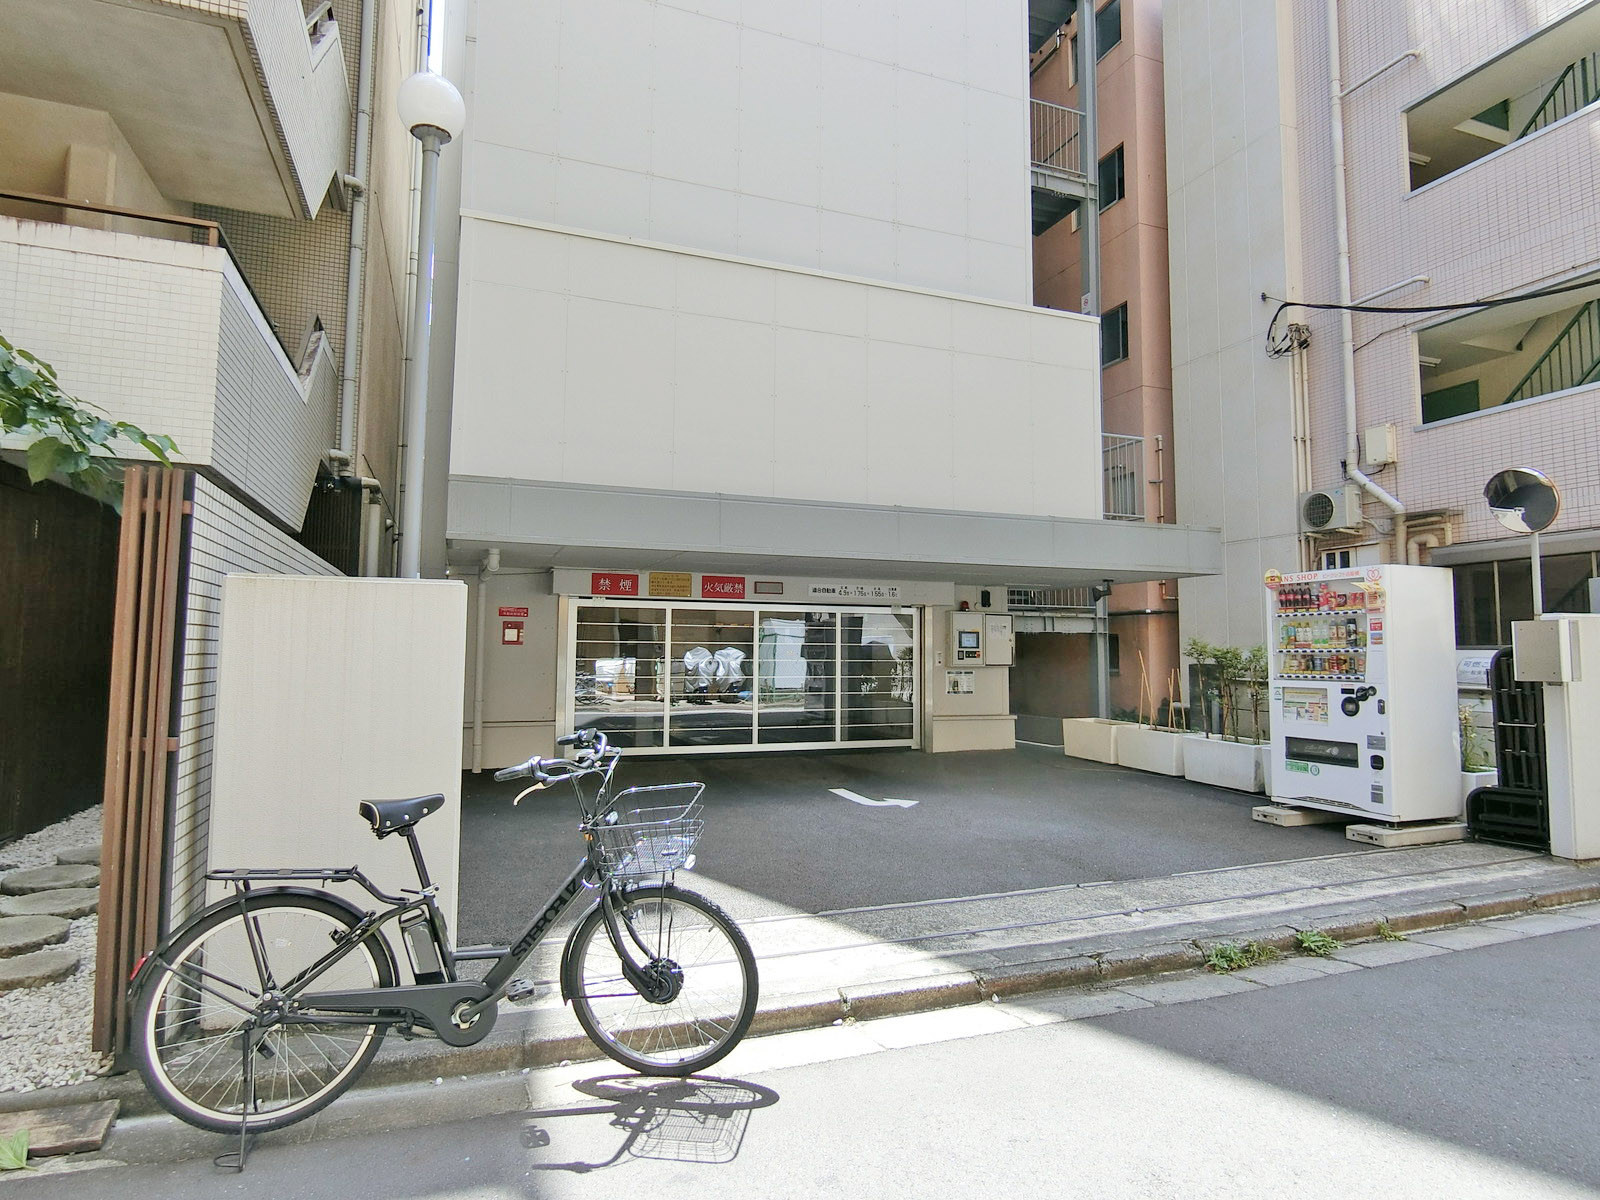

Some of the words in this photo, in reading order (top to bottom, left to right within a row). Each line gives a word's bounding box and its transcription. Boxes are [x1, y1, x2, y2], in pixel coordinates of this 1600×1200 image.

[1296, 573, 1318, 581] SHOP
[704, 581, 744, 594] 火気厳禁
